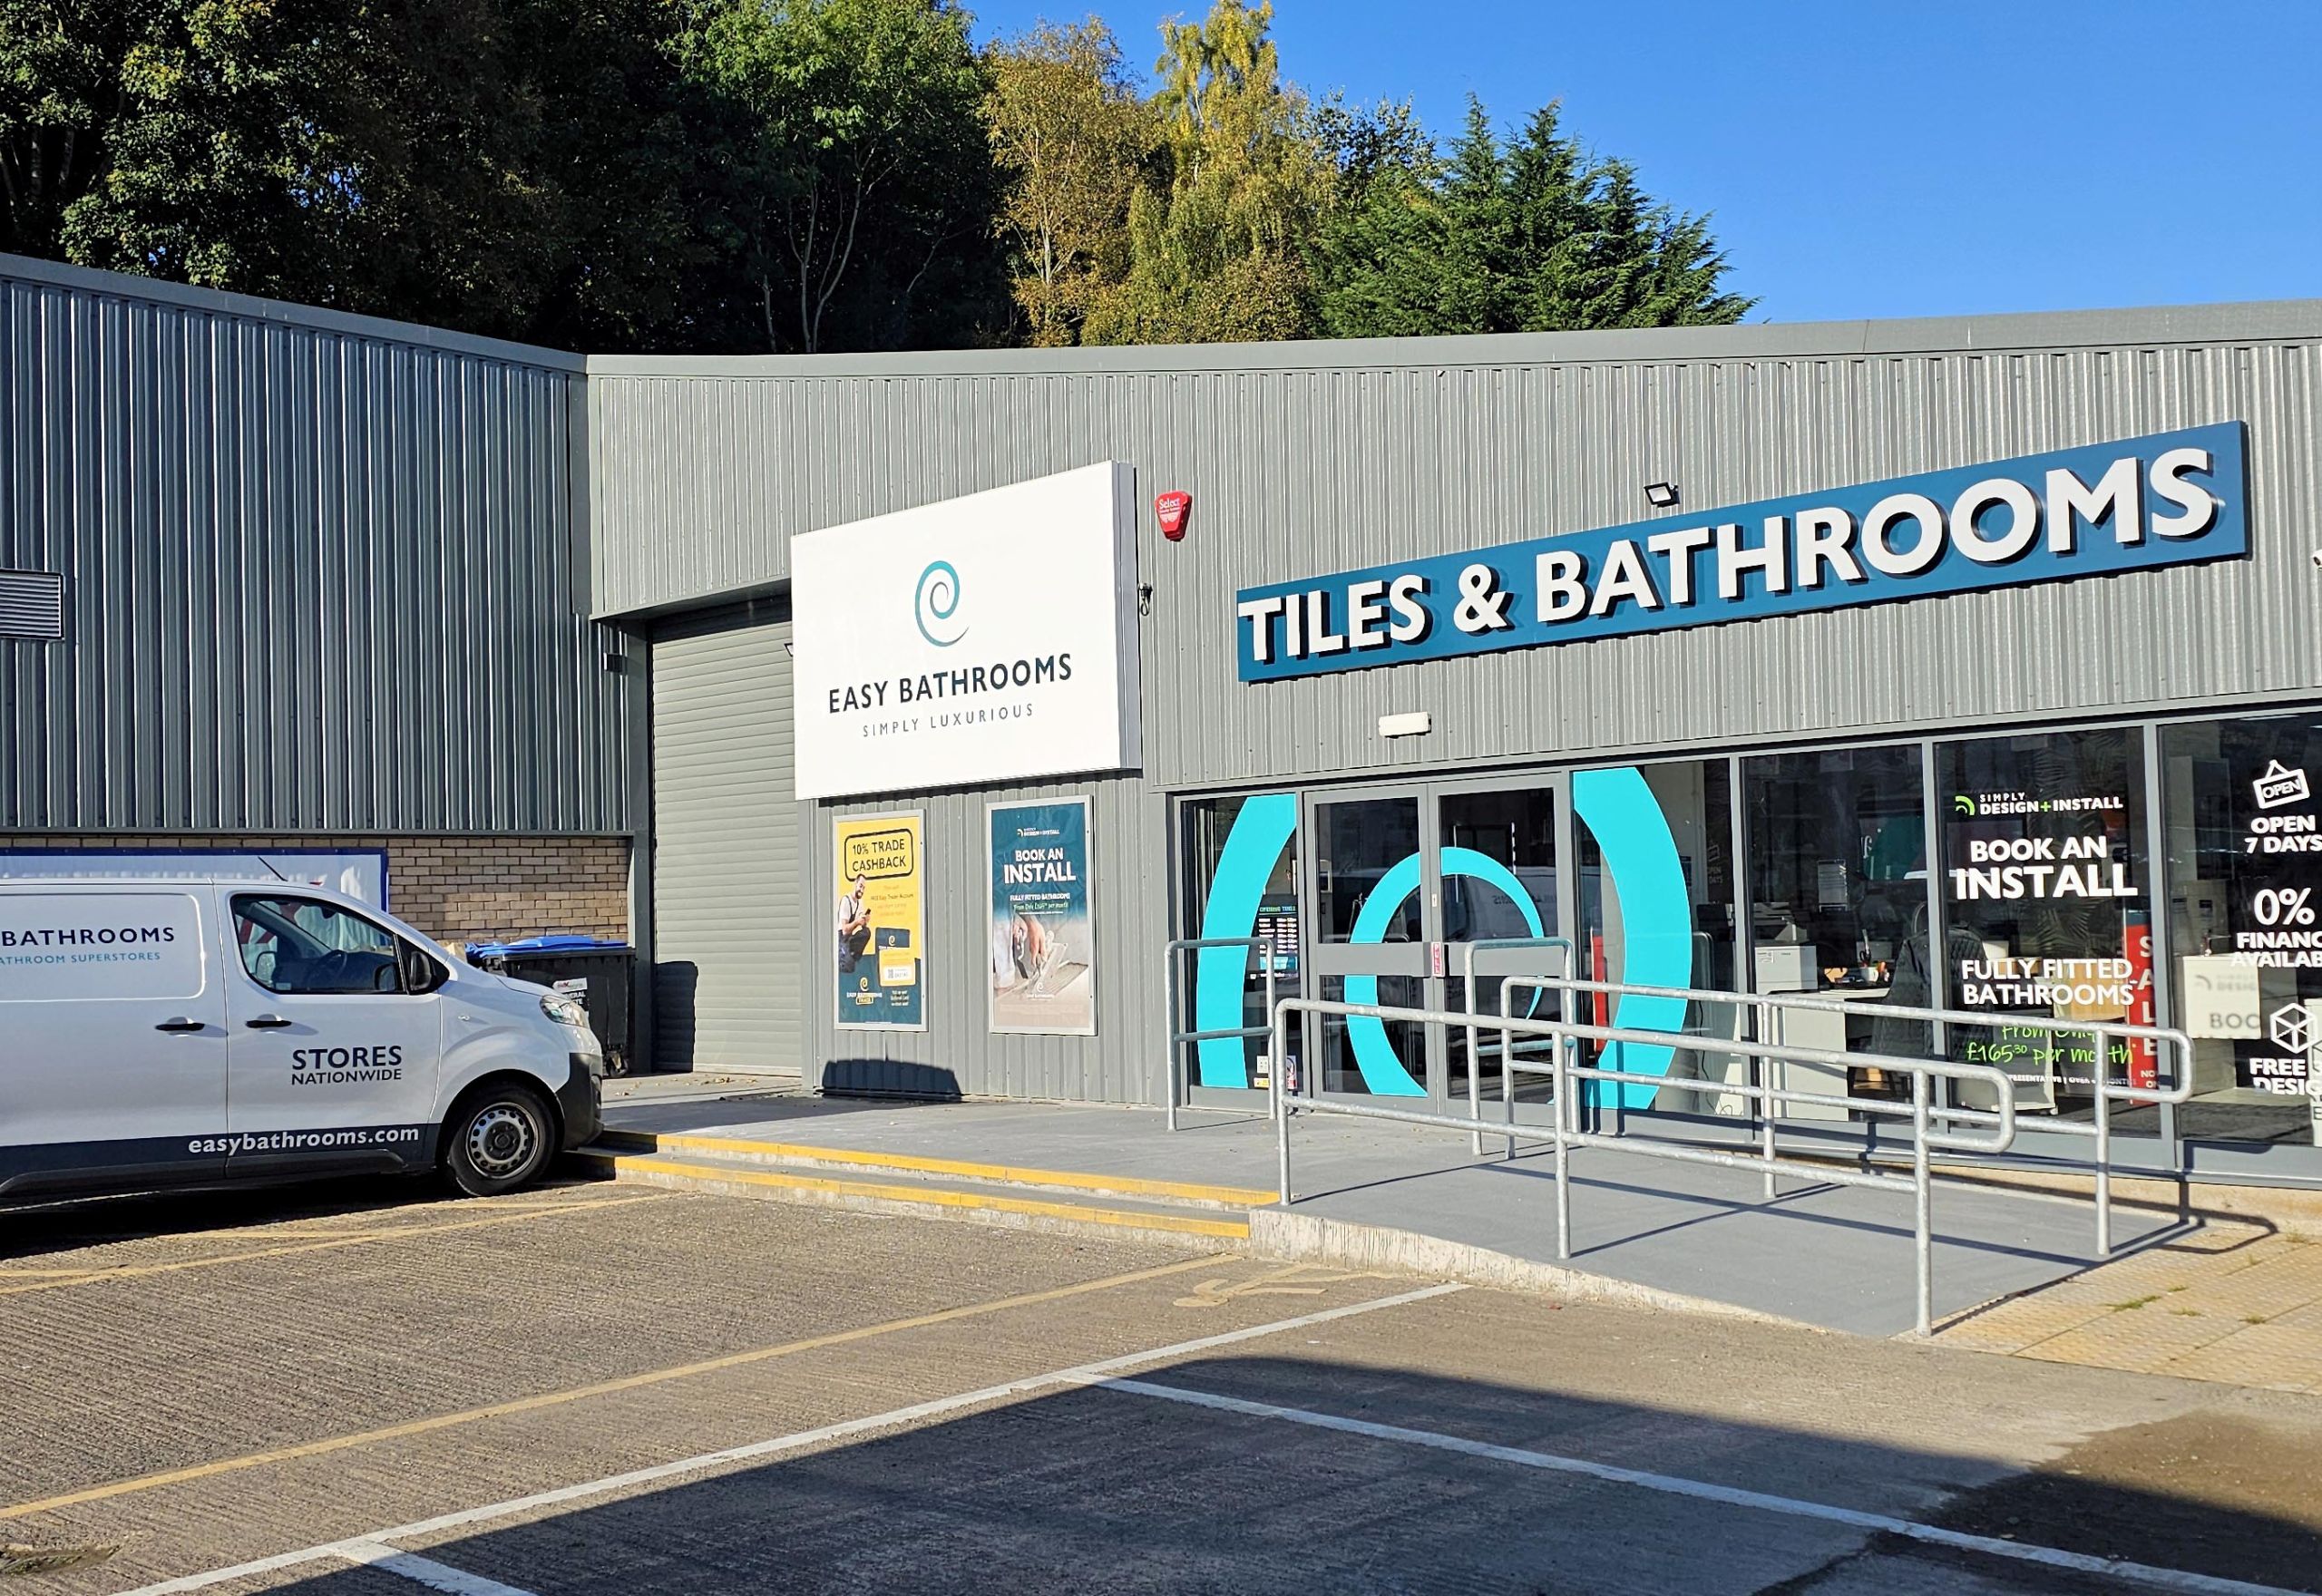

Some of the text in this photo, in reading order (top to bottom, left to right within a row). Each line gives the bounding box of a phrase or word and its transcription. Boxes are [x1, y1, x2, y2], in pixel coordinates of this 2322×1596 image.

[1238, 447, 2215, 662] TILES & BATHROOMS
[829, 653, 1072, 714] EASY BATHROOMS
[863, 703, 1033, 737] SIMPLY LUXURIOUS
[1980, 793, 2025, 803] SIMPLY
[2263, 779, 2301, 799] OPEN
[2250, 815, 2316, 833] OPEN
[852, 839, 905, 855] 10% TRADE
[1970, 835, 2108, 862] BOOK AN
[2244, 834, 2322, 853] 7 DAYS
[852, 855, 906, 872] CASHBACK
[1015, 847, 1064, 861] BOOK AN
[1004, 861, 1077, 884] INSTALL
[1956, 863, 2139, 900] INSTALL
[2253, 888, 2315, 925] 0%
[1, 927, 174, 947] BATHROOMS
[71, 952, 161, 963] SUPERSTORES
[1962, 959, 2132, 980] FULLY FITTED
[291, 1046, 402, 1071] STORES
[2071, 1044, 2134, 1065] moth
[291, 1069, 402, 1085] NATIONWIDE
[2249, 1058, 2307, 1076] FREE
[188, 1128, 419, 1156] easybathrooms.com
